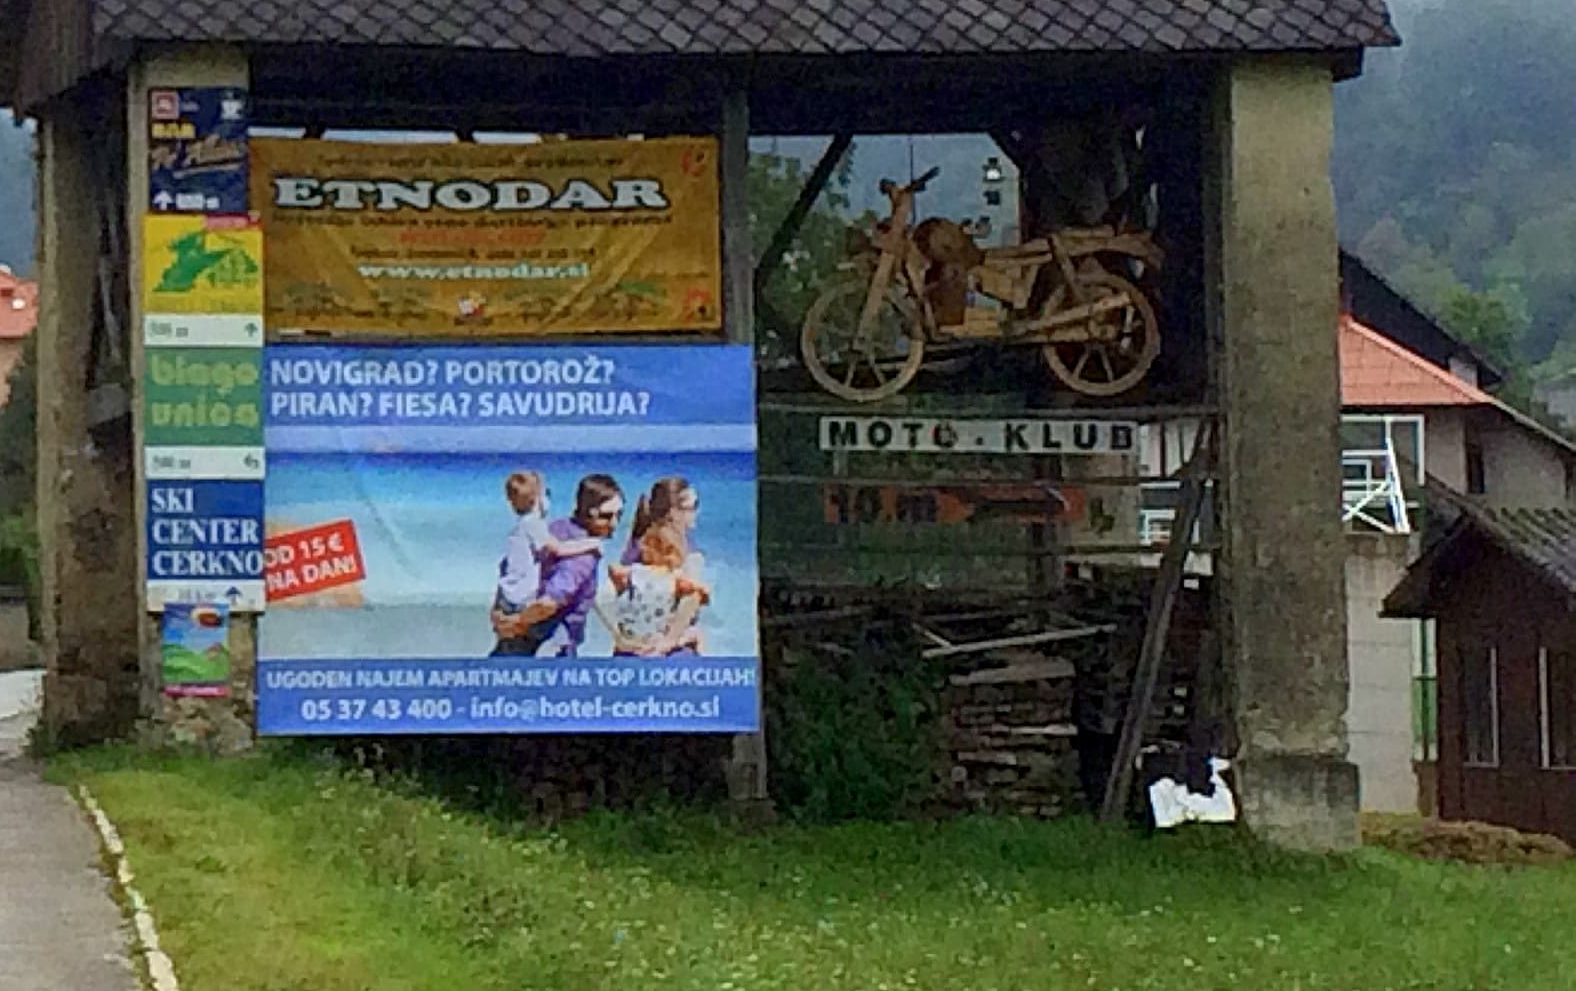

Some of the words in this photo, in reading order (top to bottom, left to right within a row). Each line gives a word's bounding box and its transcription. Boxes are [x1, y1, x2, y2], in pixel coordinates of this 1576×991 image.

[273, 176, 671, 210] ETNODAR
[270, 359, 438, 386] NOVIGRAD?
[445, 354, 616, 385] PORTOROŽ?
[270, 392, 373, 418] PIRAN?
[378, 392, 472, 418] FIESA?
[477, 391, 651, 417] SAVUDRIJA?
[1004, 423, 1134, 451] KLUB
[152, 488, 194, 513] SKI
[153, 517, 259, 544] CENTER
[153, 550, 264, 576] CERKNO
[264, 545, 296, 568] OD
[267, 569, 301, 593] NA
[266, 671, 353, 689] UGODEN
[356, 670, 424, 687] NAJEM
[428, 669, 558, 687] APARTMAJEV
[562, 668, 593, 686] NA
[596, 668, 635, 686] TOP
[301, 699, 333, 721] 05
[337, 698, 367, 720] 37
[372, 698, 403, 720] 43
[406, 698, 452, 720] 400
[469, 695, 720, 722] info@hotel-cerkno.si
